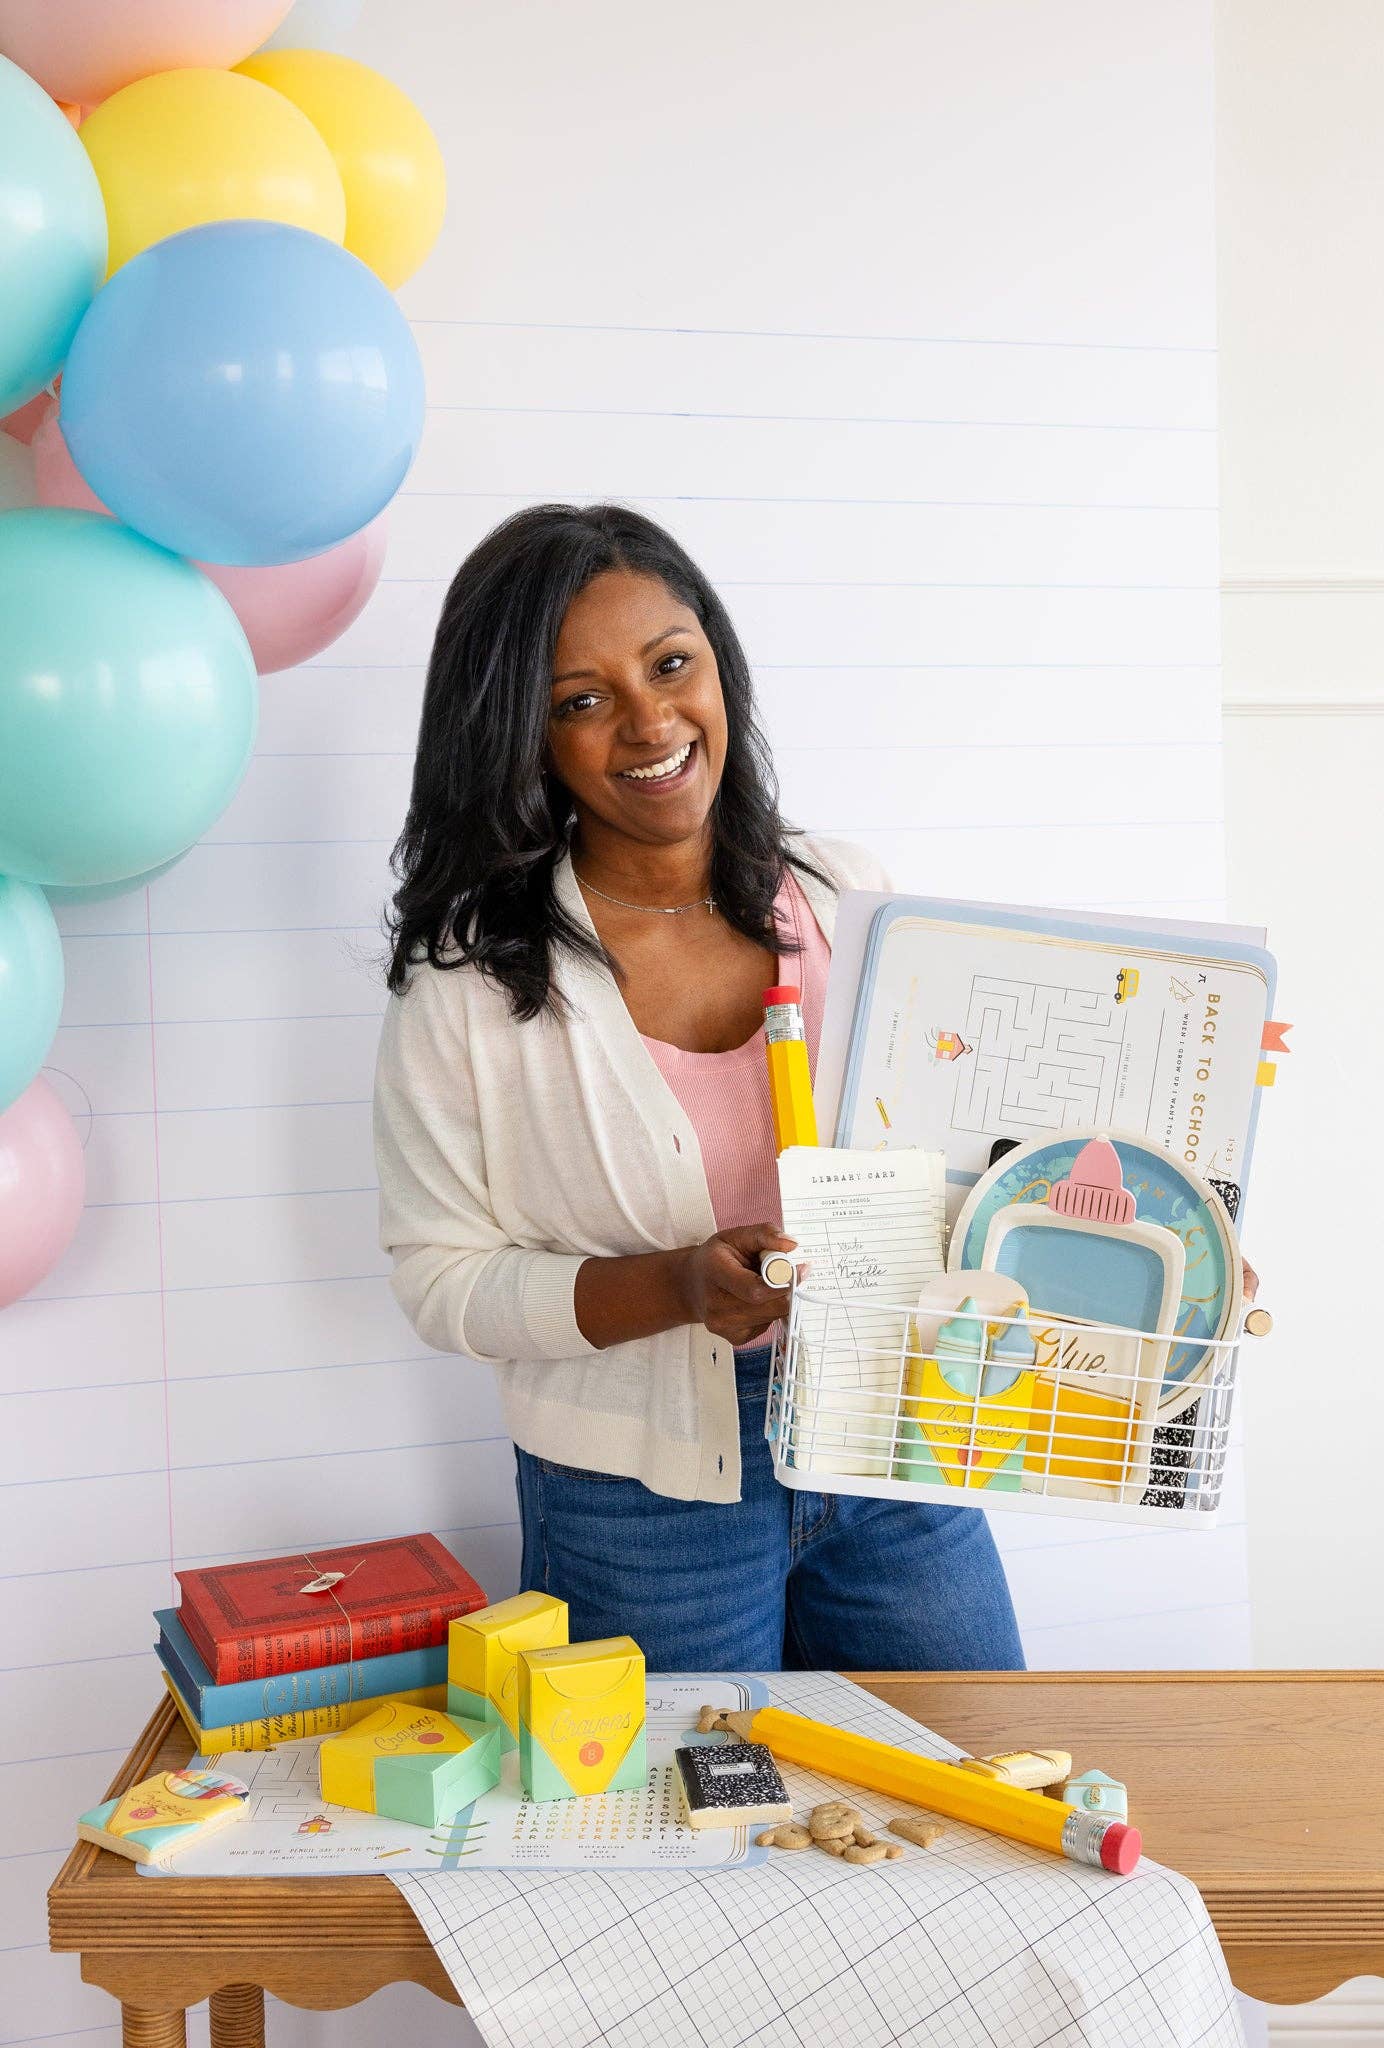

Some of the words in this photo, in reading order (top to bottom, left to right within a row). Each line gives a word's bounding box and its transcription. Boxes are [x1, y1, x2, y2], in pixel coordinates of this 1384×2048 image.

[1181, 1013, 1189, 1037] WHEN
[1201, 993, 1221, 1045] BACK
[1176, 1048, 1184, 1073] GROW
[1196, 1057, 1212, 1081] TO
[1174, 1076, 1180, 1087] UP
[1168, 1098, 1176, 1120] WANT
[1166, 1125, 1173, 1135] TO
[1184, 1092, 1206, 1164] SCHOO
[811, 1173, 862, 1184] LIBRARY
[868, 1170, 896, 1179] CARD
[1126, 1173, 1166, 1201] CAN
[838, 1264, 888, 1279] Noelle
[374, 1715, 436, 1750] Crayons
[550, 1708, 631, 1743] Crayons
